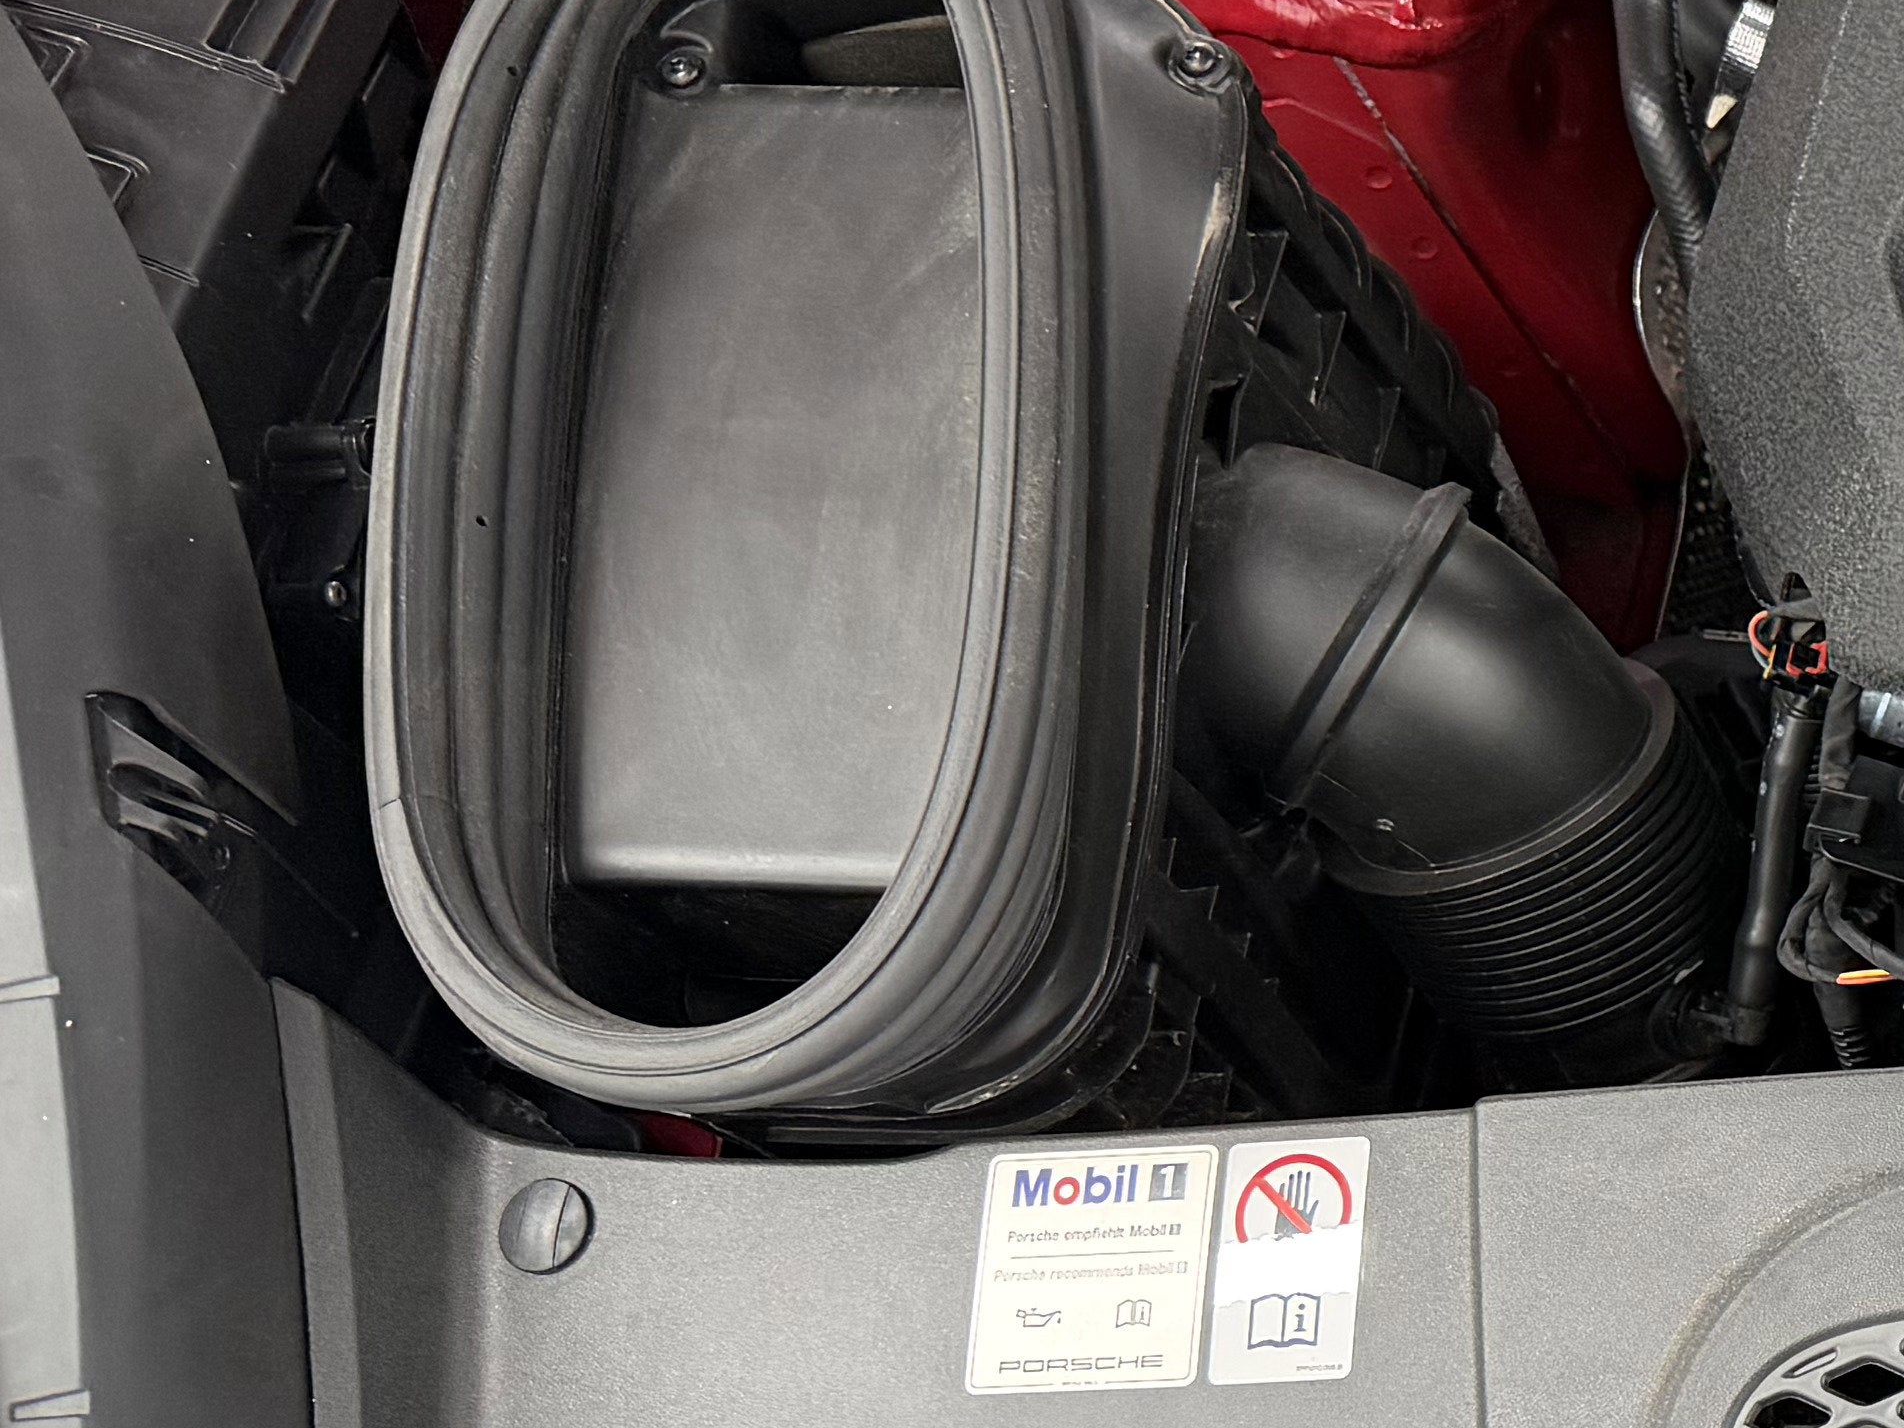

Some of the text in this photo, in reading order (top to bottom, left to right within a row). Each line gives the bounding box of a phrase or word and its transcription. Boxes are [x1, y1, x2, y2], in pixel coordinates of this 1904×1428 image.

[1011, 1164, 1139, 1207] Mobil
[1008, 1228, 1059, 1243] Porsche
[1129, 1224, 1167, 1238] Mobil
[993, 1269, 1046, 1282] Porsche
[999, 1354, 1164, 1375] PORSCHE
